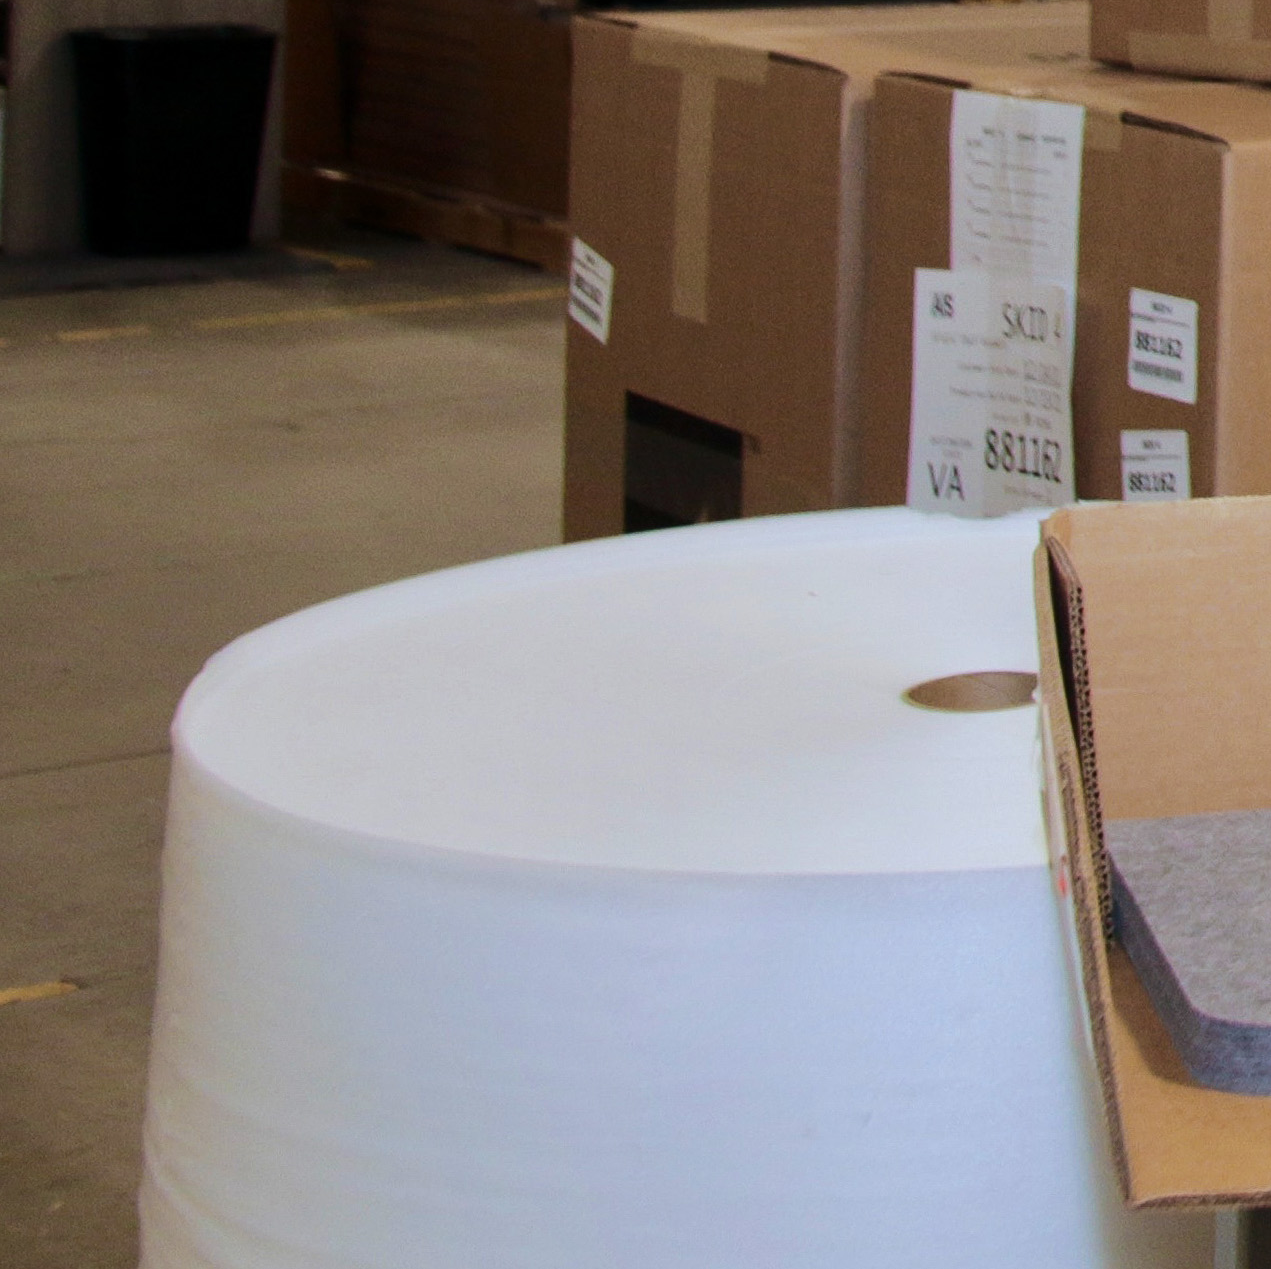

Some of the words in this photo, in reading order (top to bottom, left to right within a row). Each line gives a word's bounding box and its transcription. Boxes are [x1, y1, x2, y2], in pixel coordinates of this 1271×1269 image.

[1002, 303, 1047, 342] SKID
[1134, 330, 1182, 360] 881162
[984, 429, 1063, 483] 881162
[926, 462, 965, 501] VA
[1129, 471, 1177, 493] 881162
